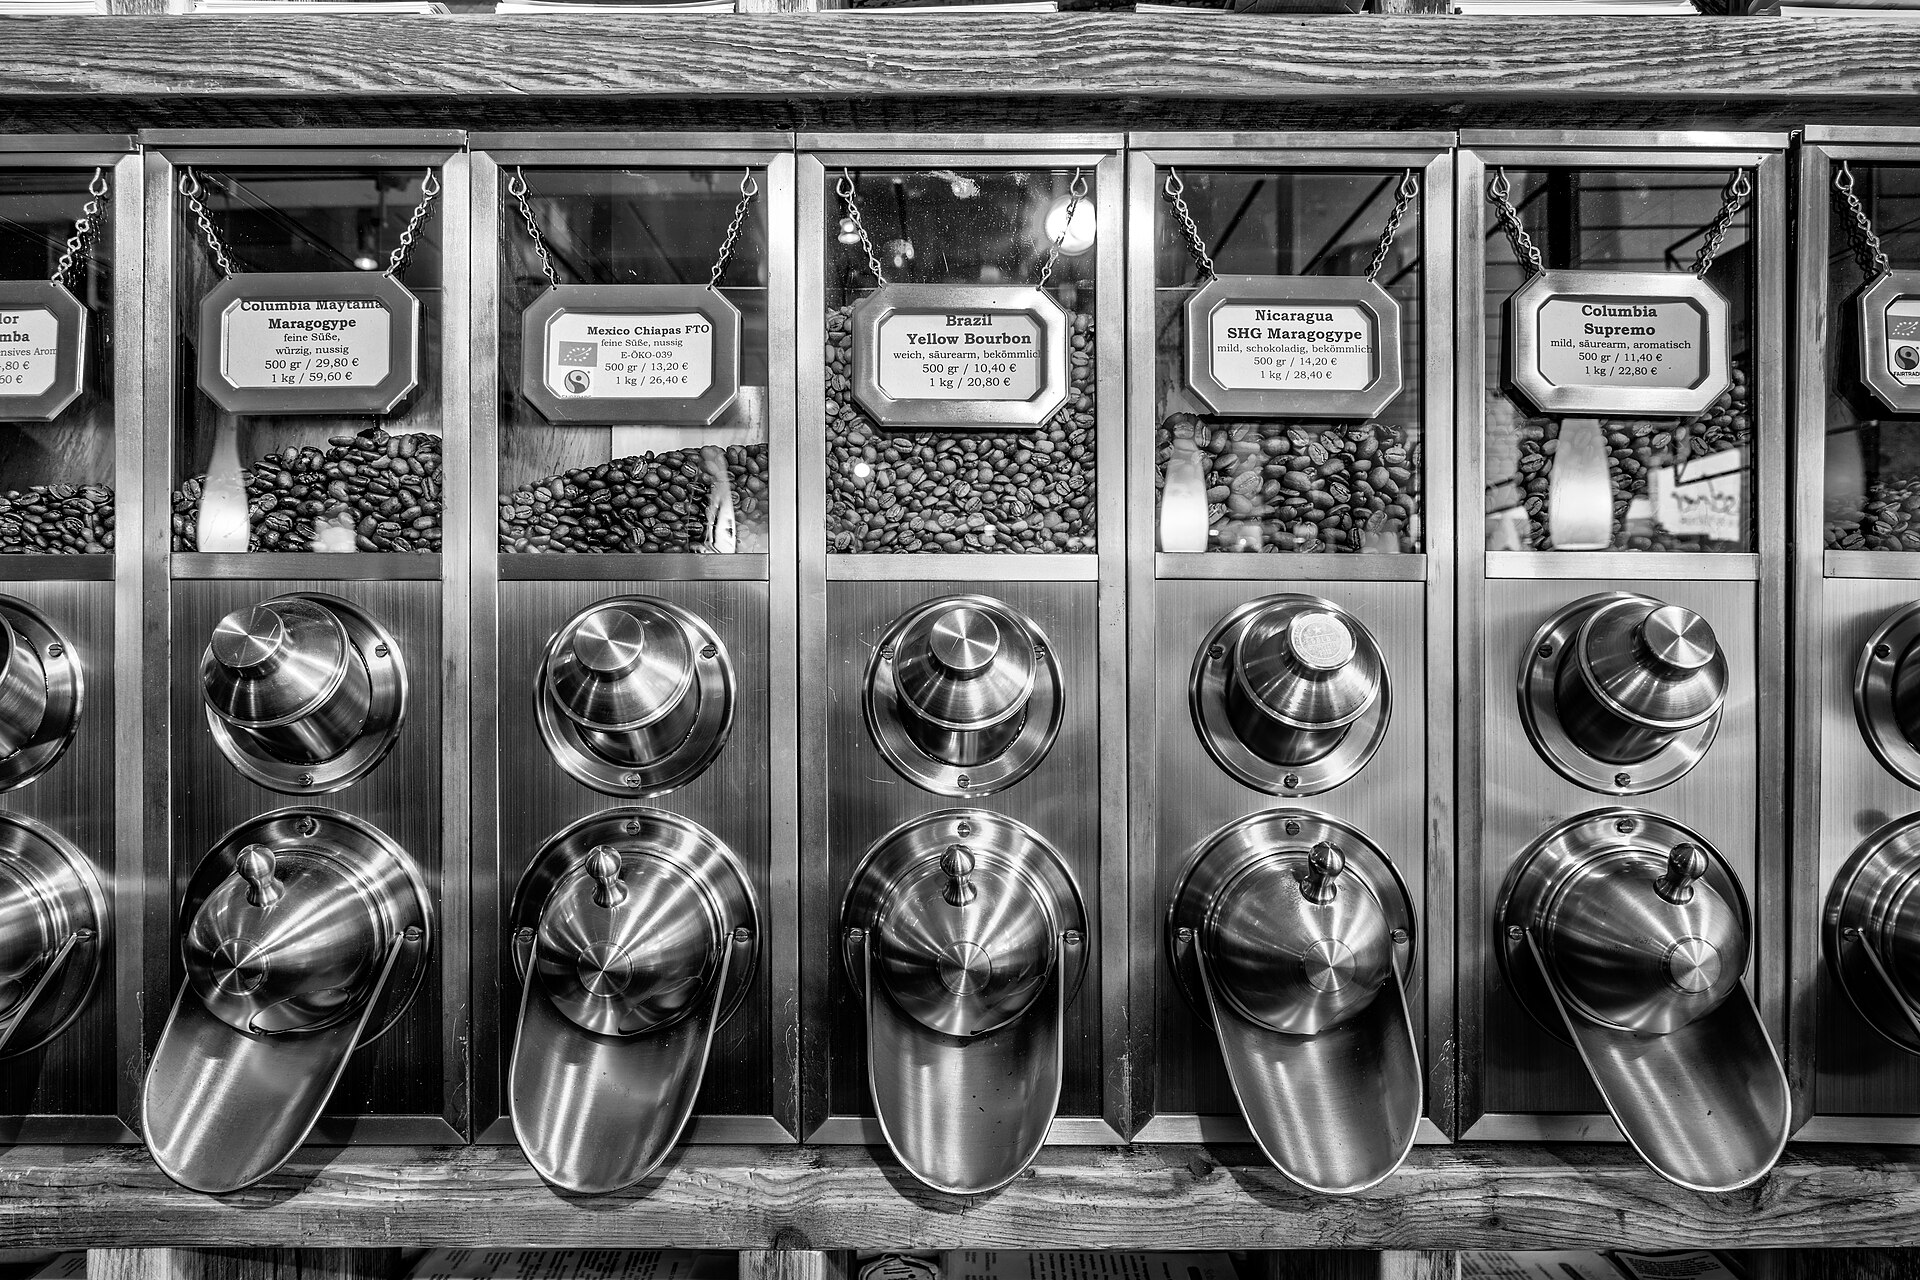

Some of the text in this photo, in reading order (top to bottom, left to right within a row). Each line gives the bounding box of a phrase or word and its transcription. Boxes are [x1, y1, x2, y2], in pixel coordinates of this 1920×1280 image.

[240, 300, 311, 311] Columbia
[1581, 304, 1658, 318] Columbia
[945, 314, 993, 327] Brazil
[1255, 309, 1334, 324] Nicaragua
[268, 318, 357, 331] Maragogype
[587, 324, 710, 337] Mexico Chiapas FTO
[1227, 327, 1362, 343] SHG Maragogype
[1584, 323, 1656, 338] Supremo
[284, 333, 341, 342] feine Süße,
[601, 338, 683, 348] feine Süße, nussig
[906, 332, 1032, 345] Yellow Bourbon
[1217, 344, 1373, 355] mild, schokoladig, bekömmlich
[1550, 339, 1691, 350] mild, säurearm, aromatisch
[0, 347, 31, 357] nsives
[275, 345, 350, 356] würzig, nussig
[621, 350, 673, 359] E-ÖKO-039
[893, 351, 925, 360] weich,
[928, 350, 980, 360] säurearm,
[1253, 357, 1337, 367] 500 gr / 14,20 €
[1578, 352, 1663, 363] 500 gr / 11,40 €
[0, 360, 30, 372] ,80 €
[264, 357, 359, 371] 500 gr / 29,80 €
[604, 362, 689, 373] 500 gr / 13,20 €
[922, 363, 1017, 375] 500 gr / 10,40 €
[1260, 370, 1332, 381] 1 kg / 28,40 €
[1585, 366, 1658, 377] 1 kg / 22,80 €
[16, 374, 23, 384] €
[272, 371, 353, 384] 1 kg / 59,60 €
[615, 375, 688, 386] 1 kg / 26,40 €
[930, 377, 1011, 389] 1 kg / 20,80 €
